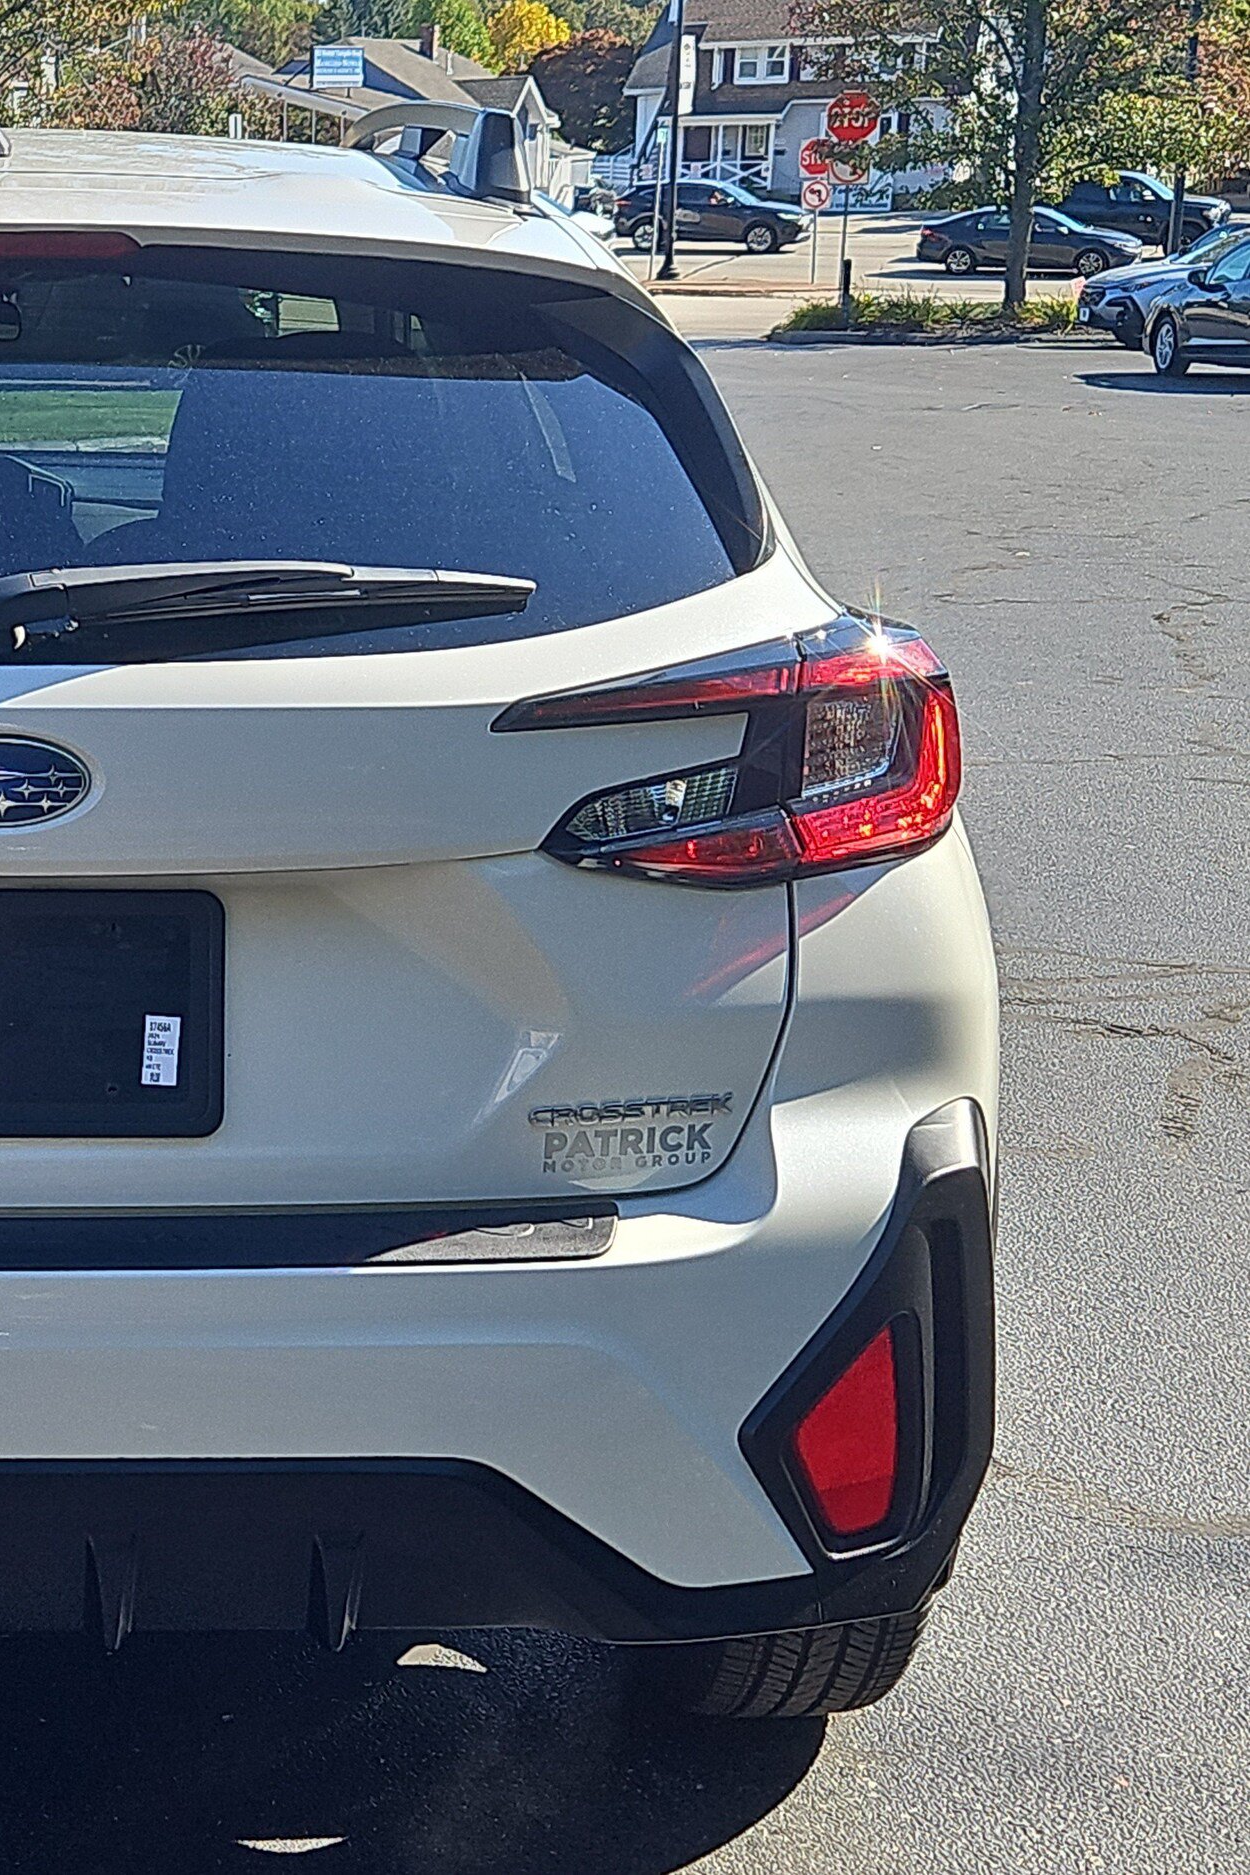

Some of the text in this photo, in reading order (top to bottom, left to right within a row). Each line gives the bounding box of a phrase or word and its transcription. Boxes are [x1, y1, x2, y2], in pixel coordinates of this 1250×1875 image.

[528, 1091, 733, 1127] CROSSTREK
[544, 1122, 714, 1159] PATRICK
[542, 1150, 712, 1173] MOTOR GROUP
